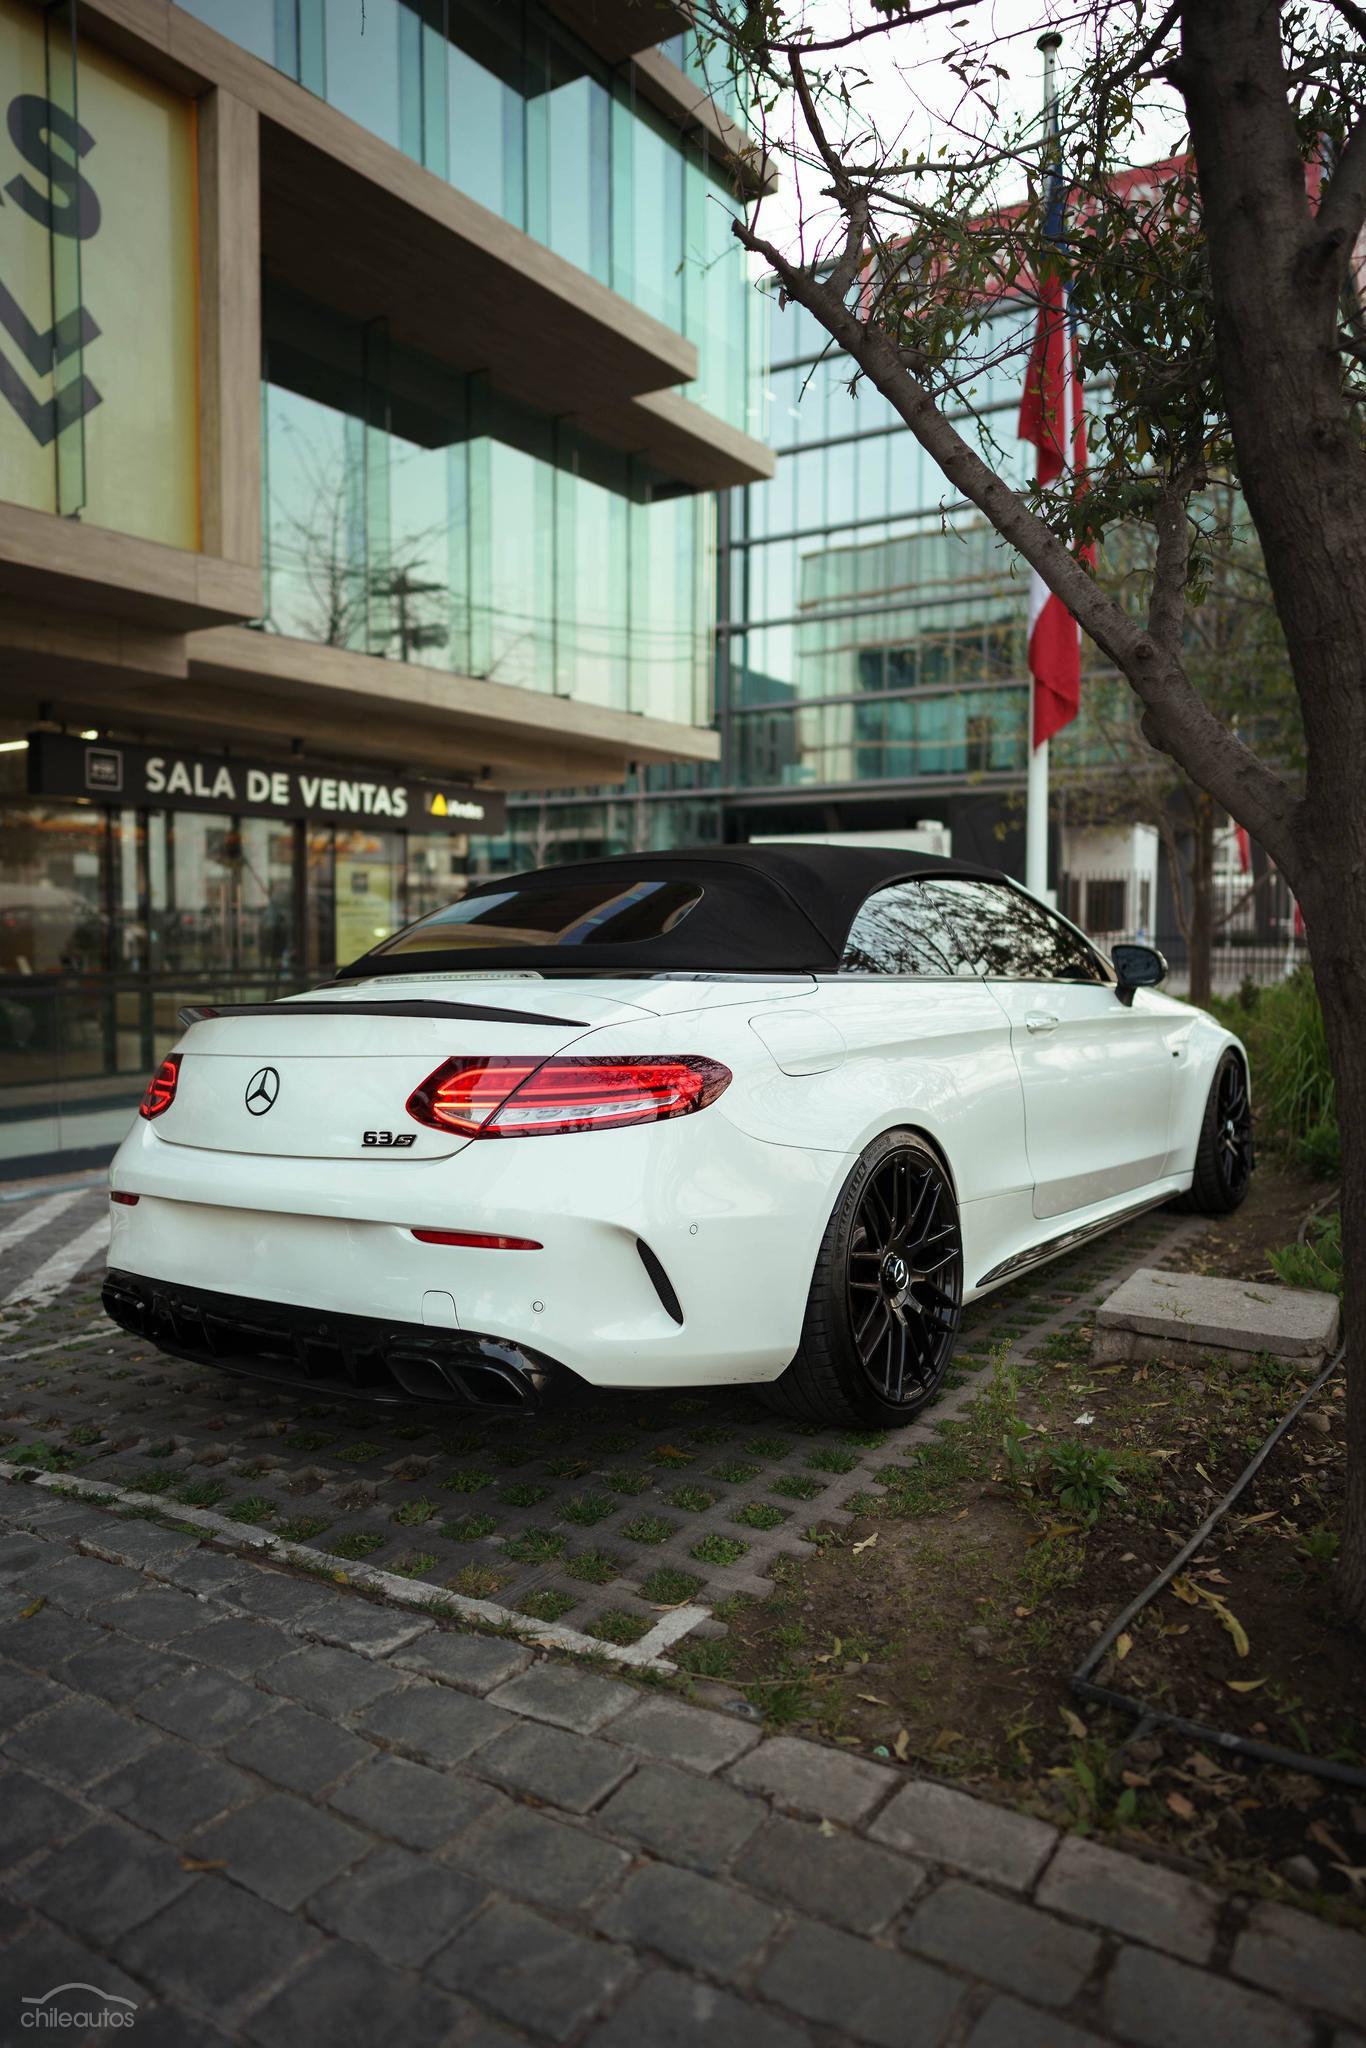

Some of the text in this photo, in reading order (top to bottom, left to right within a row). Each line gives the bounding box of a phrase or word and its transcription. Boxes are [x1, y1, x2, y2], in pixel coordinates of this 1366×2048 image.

[146, 758, 236, 799] SALA
[247, 769, 290, 806] DE
[299, 775, 408, 818] VENTAS
[838, 1161, 868, 1237] MICHELIN
